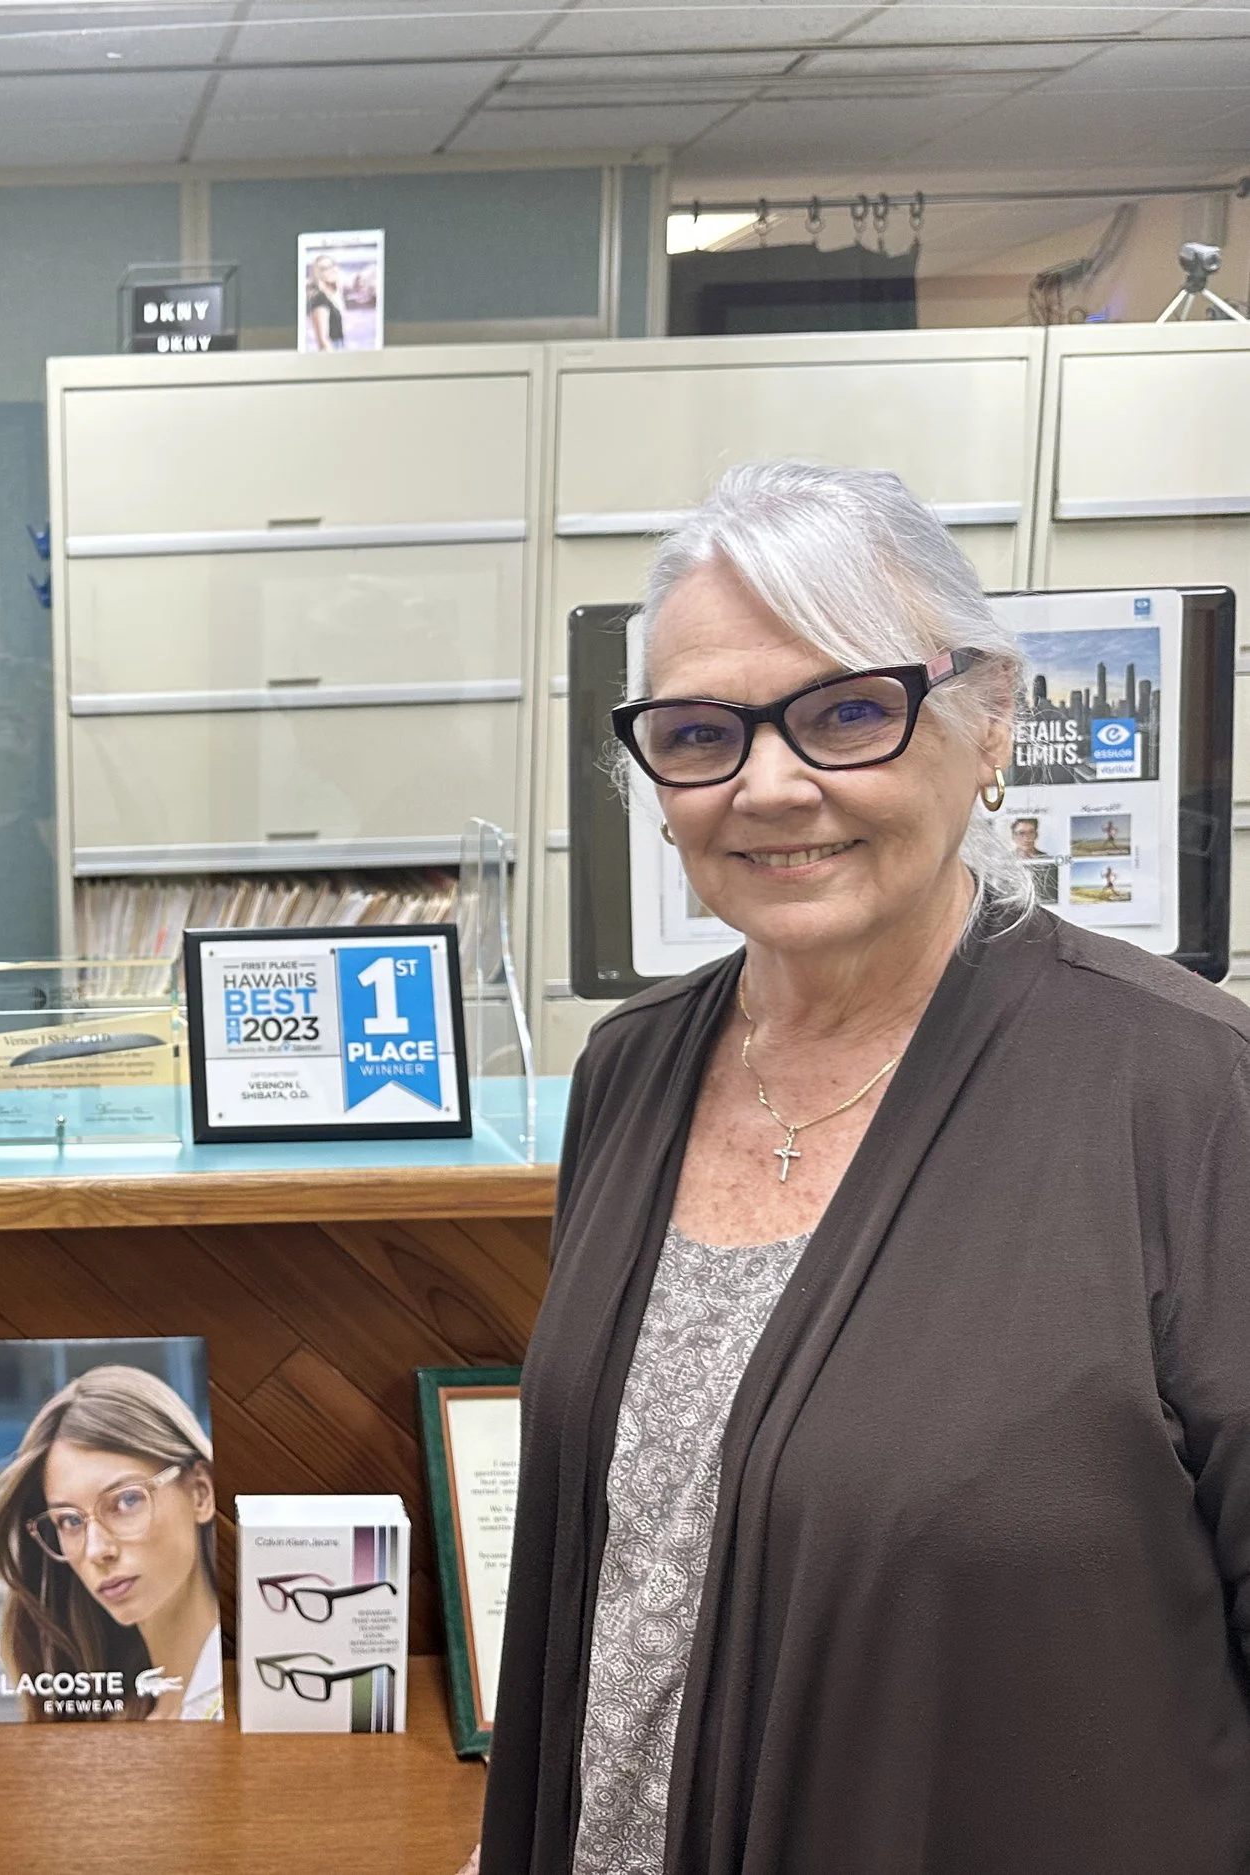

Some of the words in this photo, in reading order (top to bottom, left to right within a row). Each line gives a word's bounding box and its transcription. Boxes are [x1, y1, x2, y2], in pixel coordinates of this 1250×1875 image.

[143, 300, 209, 323] DKNY
[156, 335, 212, 353] DKNY
[1013, 719, 1083, 743] ETAILS.
[1015, 743, 1083, 767] LIMITS.
[241, 961, 267, 970] FIRST
[269, 960, 299, 969] PLACE
[222, 971, 318, 989] HAWAII'S
[223, 987, 318, 1016] BEST
[242, 1015, 320, 1042] 2023
[347, 1040, 436, 1062] PLACE
[359, 1063, 426, 1076] WINNER
[248, 1080, 293, 1090] VERNON
[0, 1671, 124, 1696] LACOSTE
[43, 1699, 124, 1714] EYEWEAR
